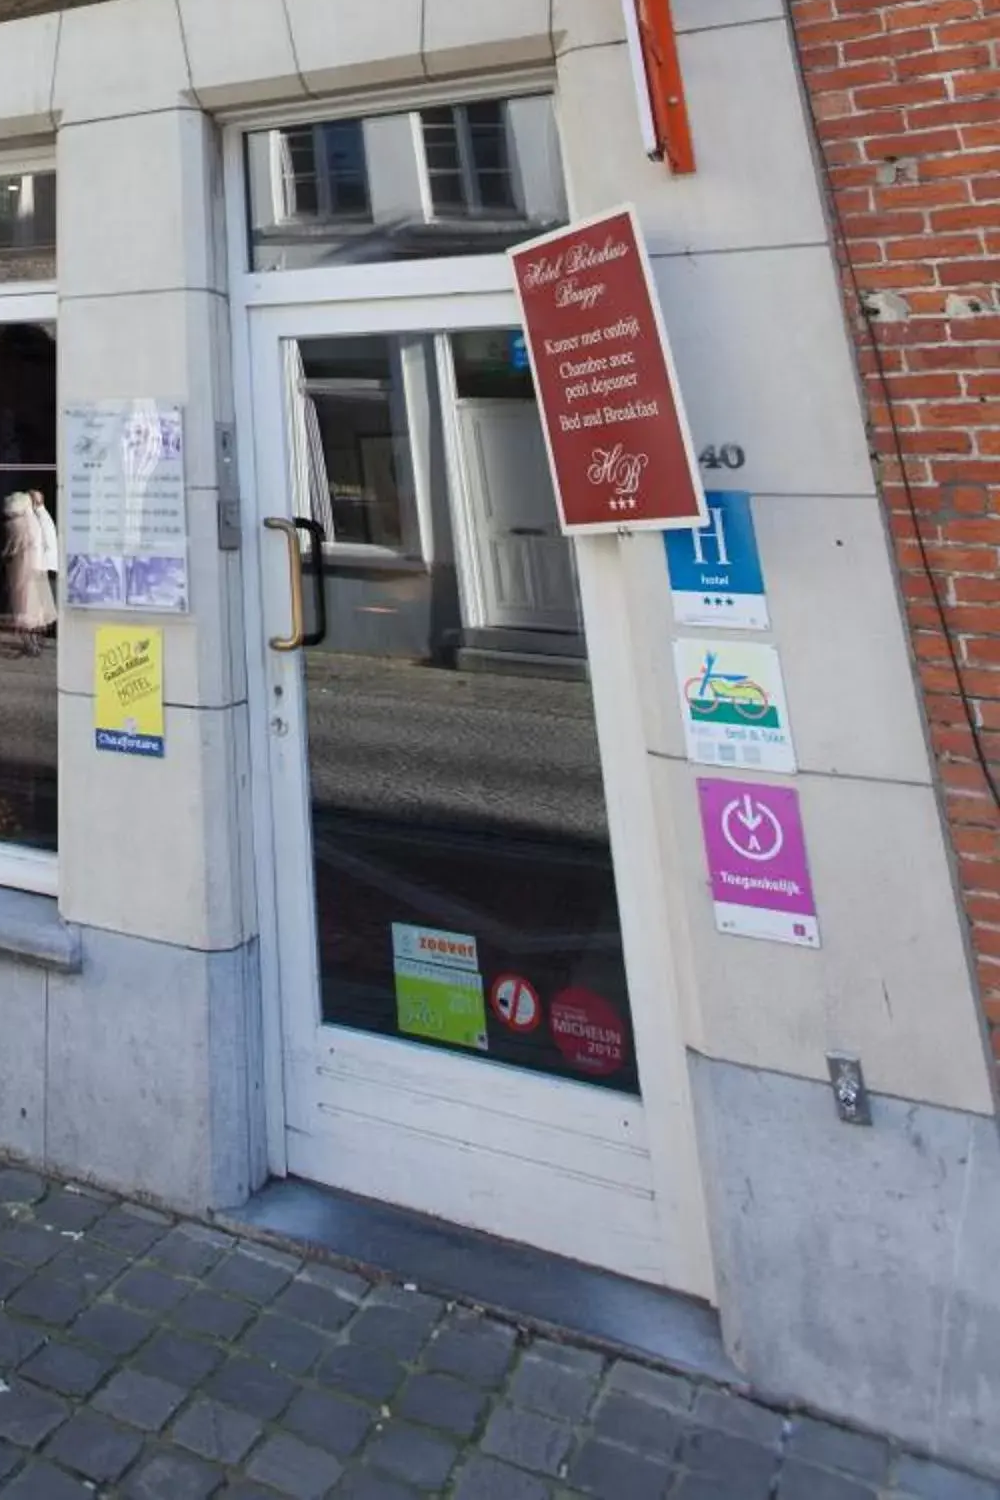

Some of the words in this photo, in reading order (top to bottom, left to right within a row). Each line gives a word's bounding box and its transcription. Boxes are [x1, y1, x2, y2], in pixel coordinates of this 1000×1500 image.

[523, 254, 564, 289] Hotel
[544, 336, 579, 355] Kamer
[581, 328, 601, 345] met
[560, 357, 608, 378] Chambre
[609, 351, 636, 368] avec
[565, 380, 588, 404] petit
[560, 413, 581, 431] Bed
[583, 408, 602, 426] and
[603, 401, 659, 423] Breakfast
[699, 444, 745, 468] 40
[692, 508, 732, 564] H
[701, 573, 729, 585] hotel
[720, 871, 801, 896] Toegankelijk
[552, 1017, 621, 1044] MICHELIN
